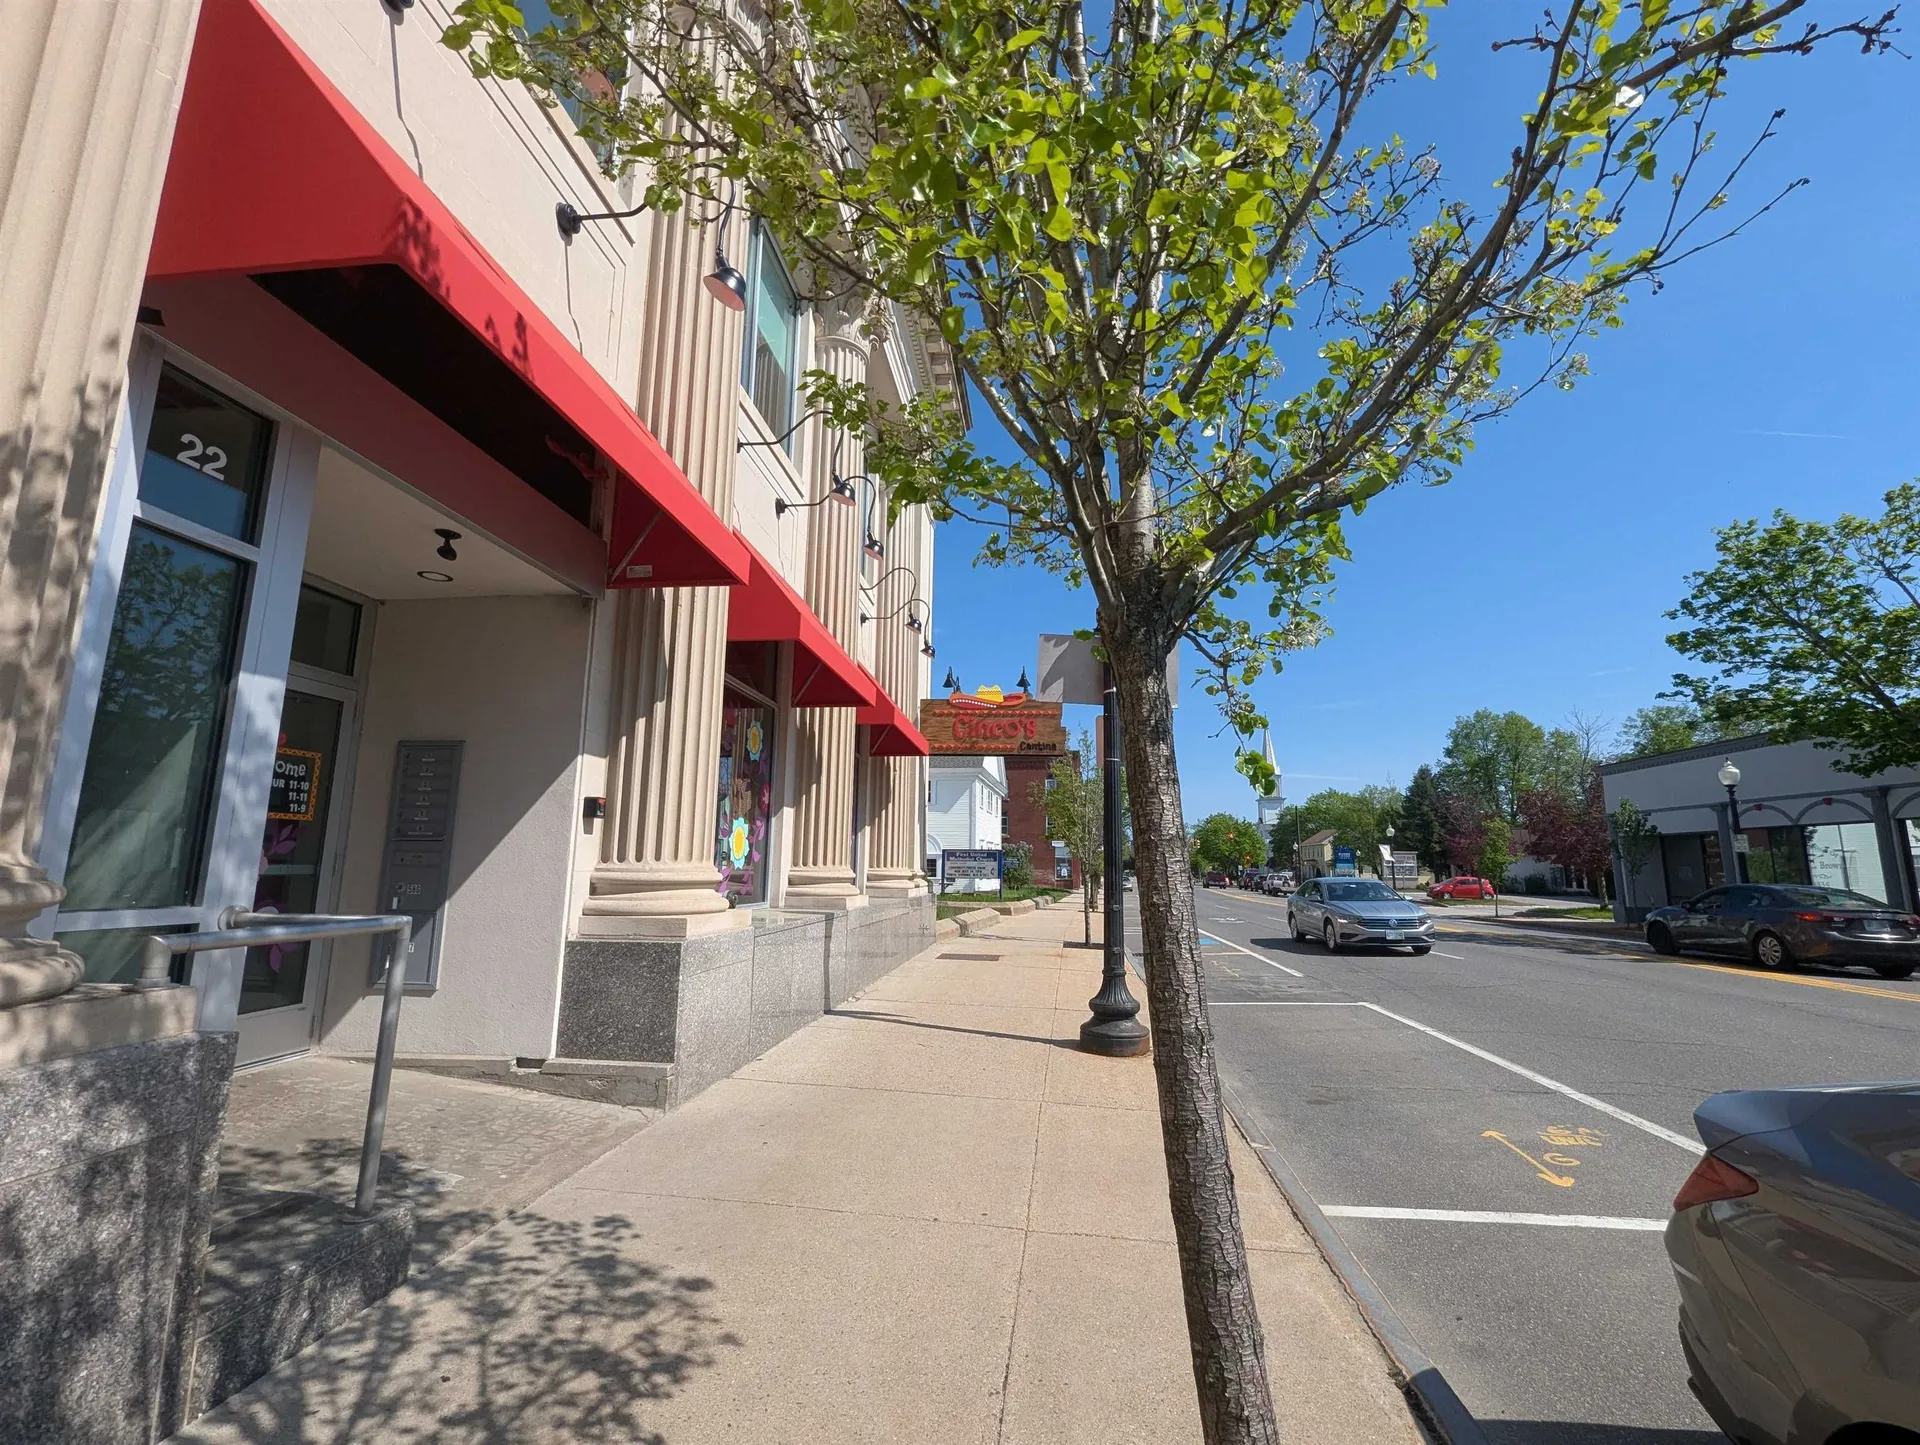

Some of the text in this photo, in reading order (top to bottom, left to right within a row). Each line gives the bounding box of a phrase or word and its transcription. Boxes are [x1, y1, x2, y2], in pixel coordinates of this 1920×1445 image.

[176, 433, 228, 481] 22
[952, 714, 1038, 740] Cinco's
[1019, 741, 1057, 752] Cantina
[289, 780, 310, 791] 11-10
[288, 791, 308, 801] 11-11
[289, 803, 307, 813] 11-9
